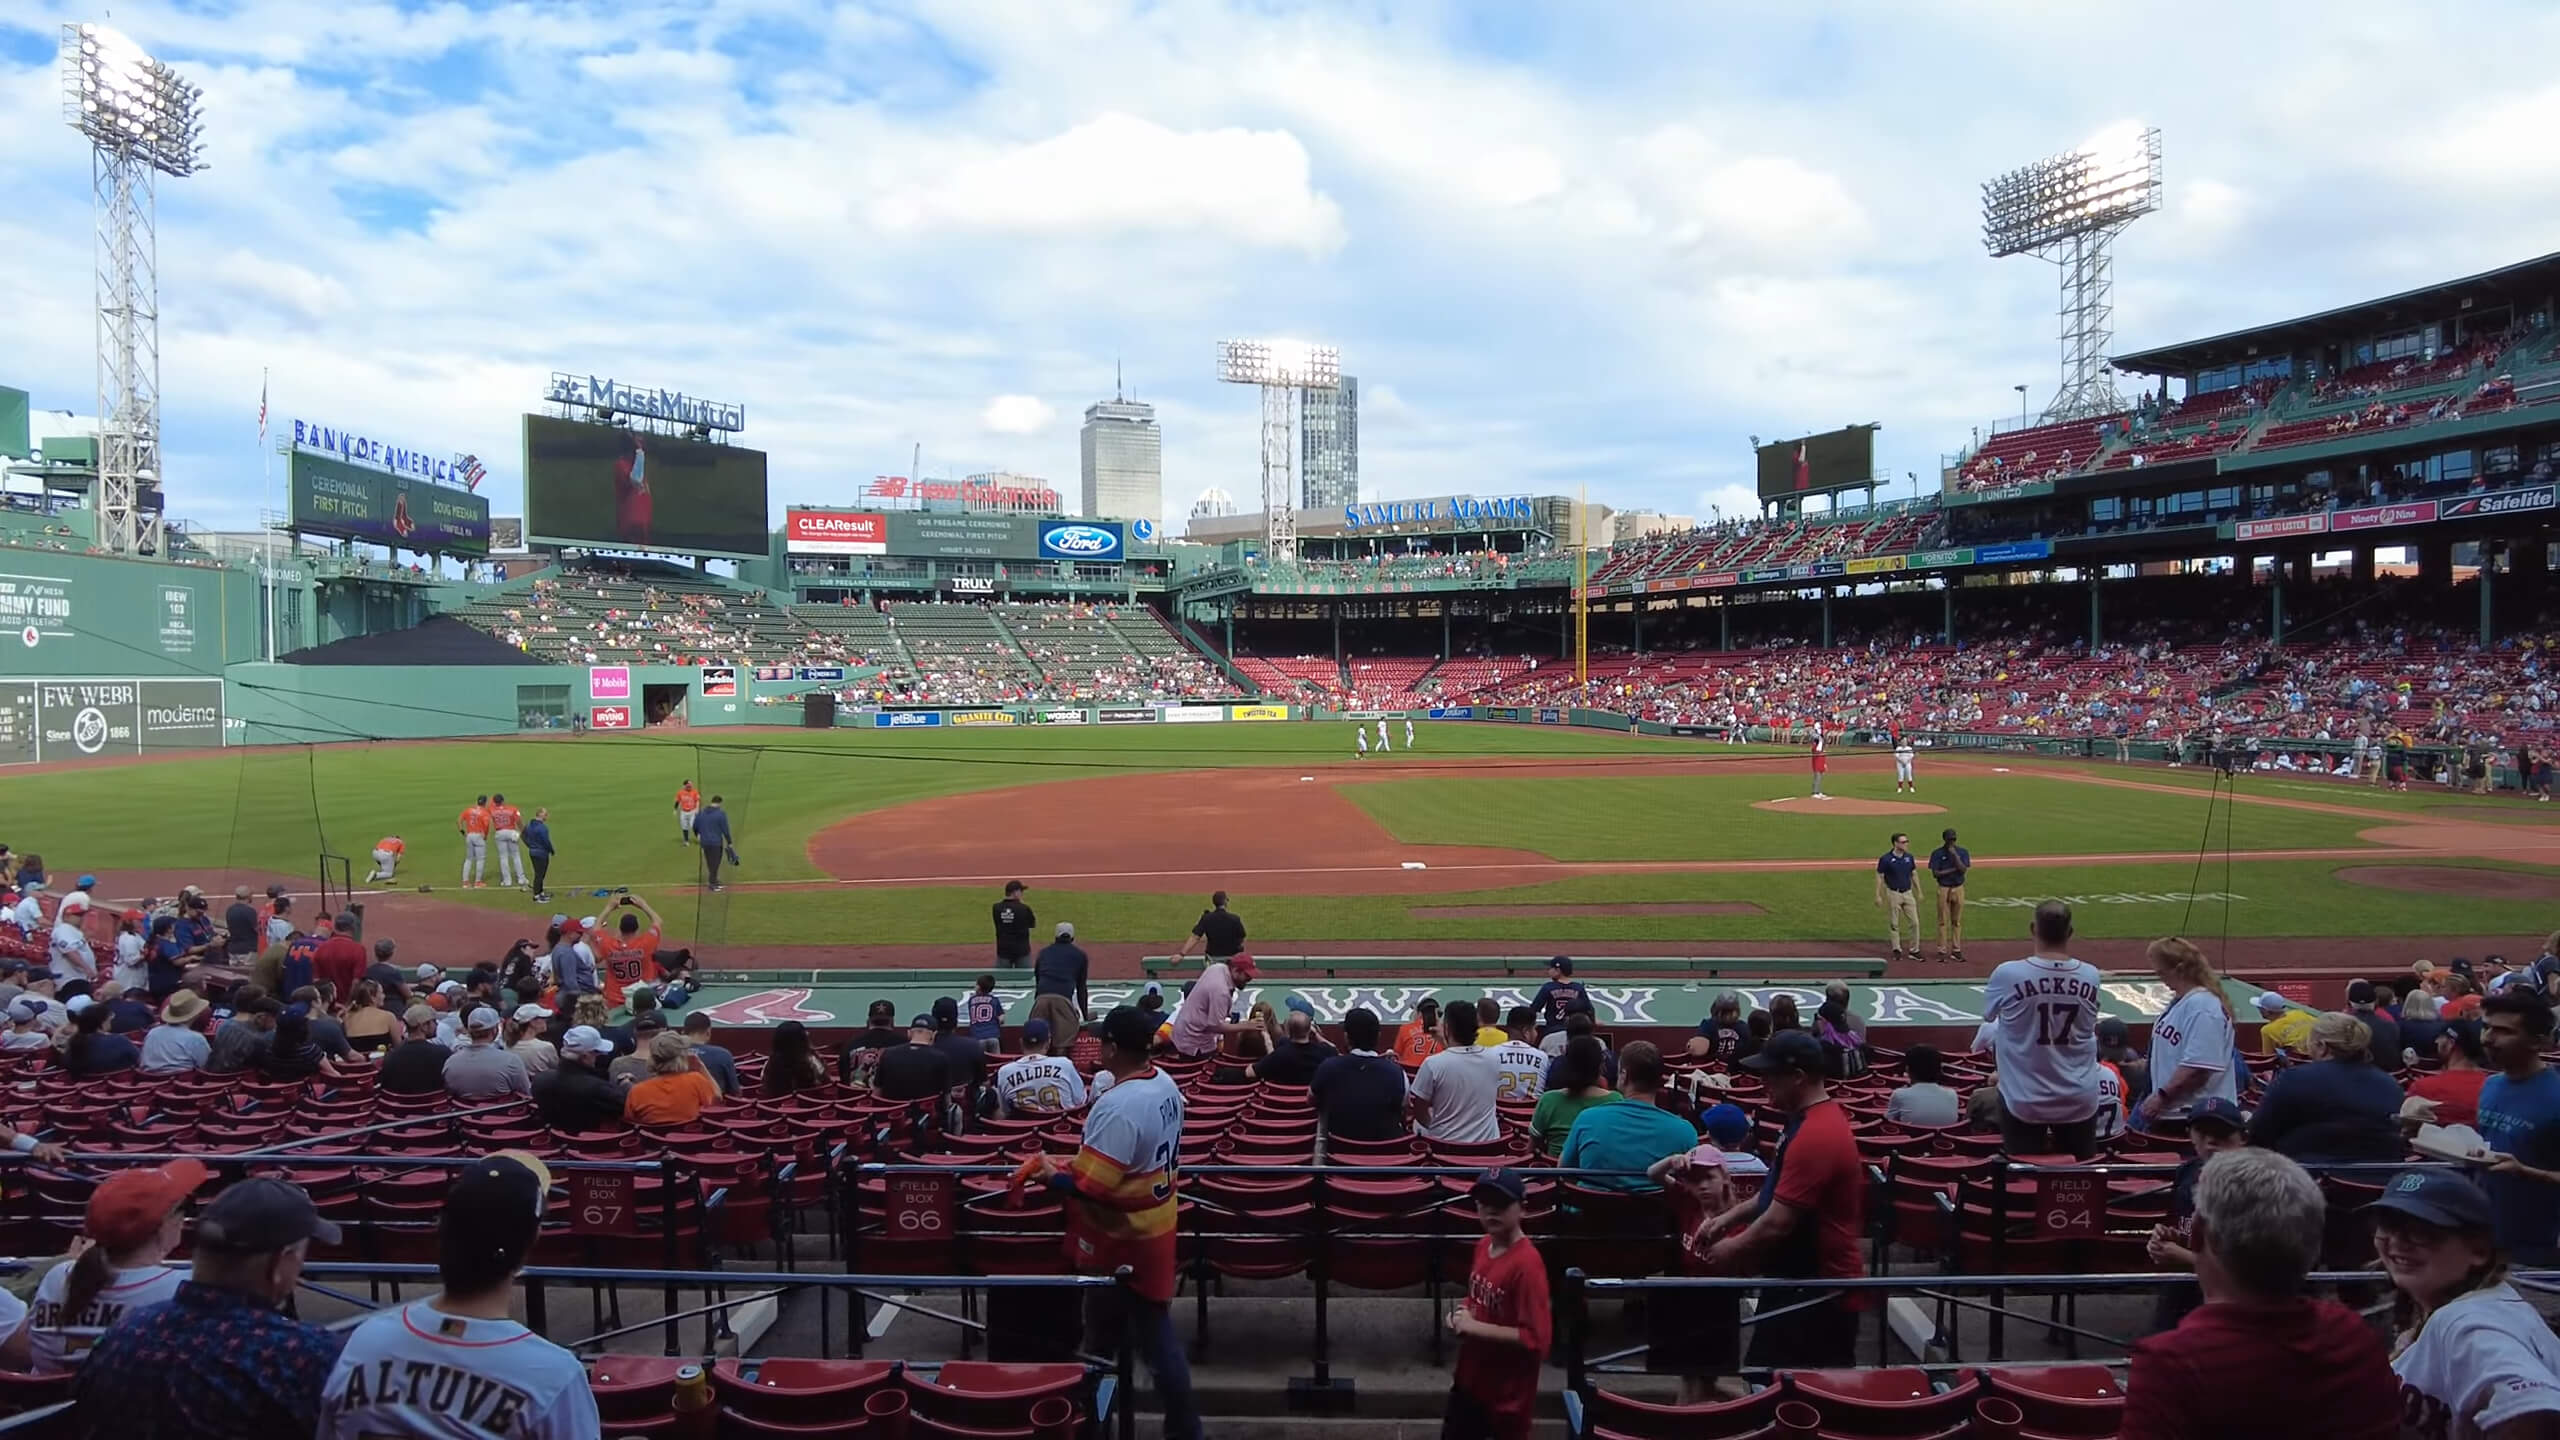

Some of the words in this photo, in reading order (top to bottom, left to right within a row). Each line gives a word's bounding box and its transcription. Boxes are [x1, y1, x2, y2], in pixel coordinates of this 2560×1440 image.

[590, 375, 744, 431] MassMutual
[295, 419, 349, 456] BANK
[357, 437, 378, 461] OF
[385, 445, 456, 481] AMERICA
[312, 476, 368, 499] CEREMONIAL
[1987, 489, 2021, 500] UNITED
[313, 495, 338, 512] FIRST
[341, 501, 368, 519] PITCH
[2479, 491, 2551, 511] Safelite
[1345, 502, 1442, 529] SAMUEL
[1447, 496, 1532, 520] ADAMS
[2351, 513, 2378, 525] Ninety
[2395, 509, 2416, 521] Nine
[799, 518, 874, 531] CLEAResult
[933, 519, 967, 527] PREGAME
[968, 520, 1011, 529] CEREMONIES
[921, 531, 965, 539] CEREMONIAL
[1060, 530, 1102, 551] Ford
[952, 578, 994, 589] TRULY
[37, 598, 70, 617] FUND
[169, 604, 185, 615] 103
[601, 677, 627, 688] Mobile
[80, 685, 133, 706] WEBB
[147, 704, 216, 724] moderna
[597, 712, 624, 722] IRVING
[891, 713, 926, 726] jetBlue
[953, 711, 993, 724] GRANITE
[995, 711, 1015, 723] CITY
[1045, 710, 1081, 721] wasabi
[613, 961, 641, 980] 50
[2013, 978, 2098, 1003] JACKSON
[970, 1004, 993, 1024] 10
[2035, 1003, 2081, 1046] 17
[1500, 1051, 1543, 1069] LTUVE
[1007, 1065, 1062, 1088] VALDEZ
[1497, 1071, 1538, 1099] 27
[1016, 1085, 1061, 1109] 59
[583, 1176, 621, 1187] FIELD
[900, 1181, 939, 1192] FIELD
[2051, 1180, 2091, 1191] FIELD
[2401, 1174, 2425, 1192] B
[590, 1190, 616, 1200] BOX
[906, 1194, 934, 1204] BOX
[2056, 1193, 2085, 1203] BOX
[583, 1206, 622, 1225] 67
[899, 1210, 942, 1231] 66
[2047, 1209, 2092, 1229] 64
[344, 1360, 528, 1436] ALTUVE
